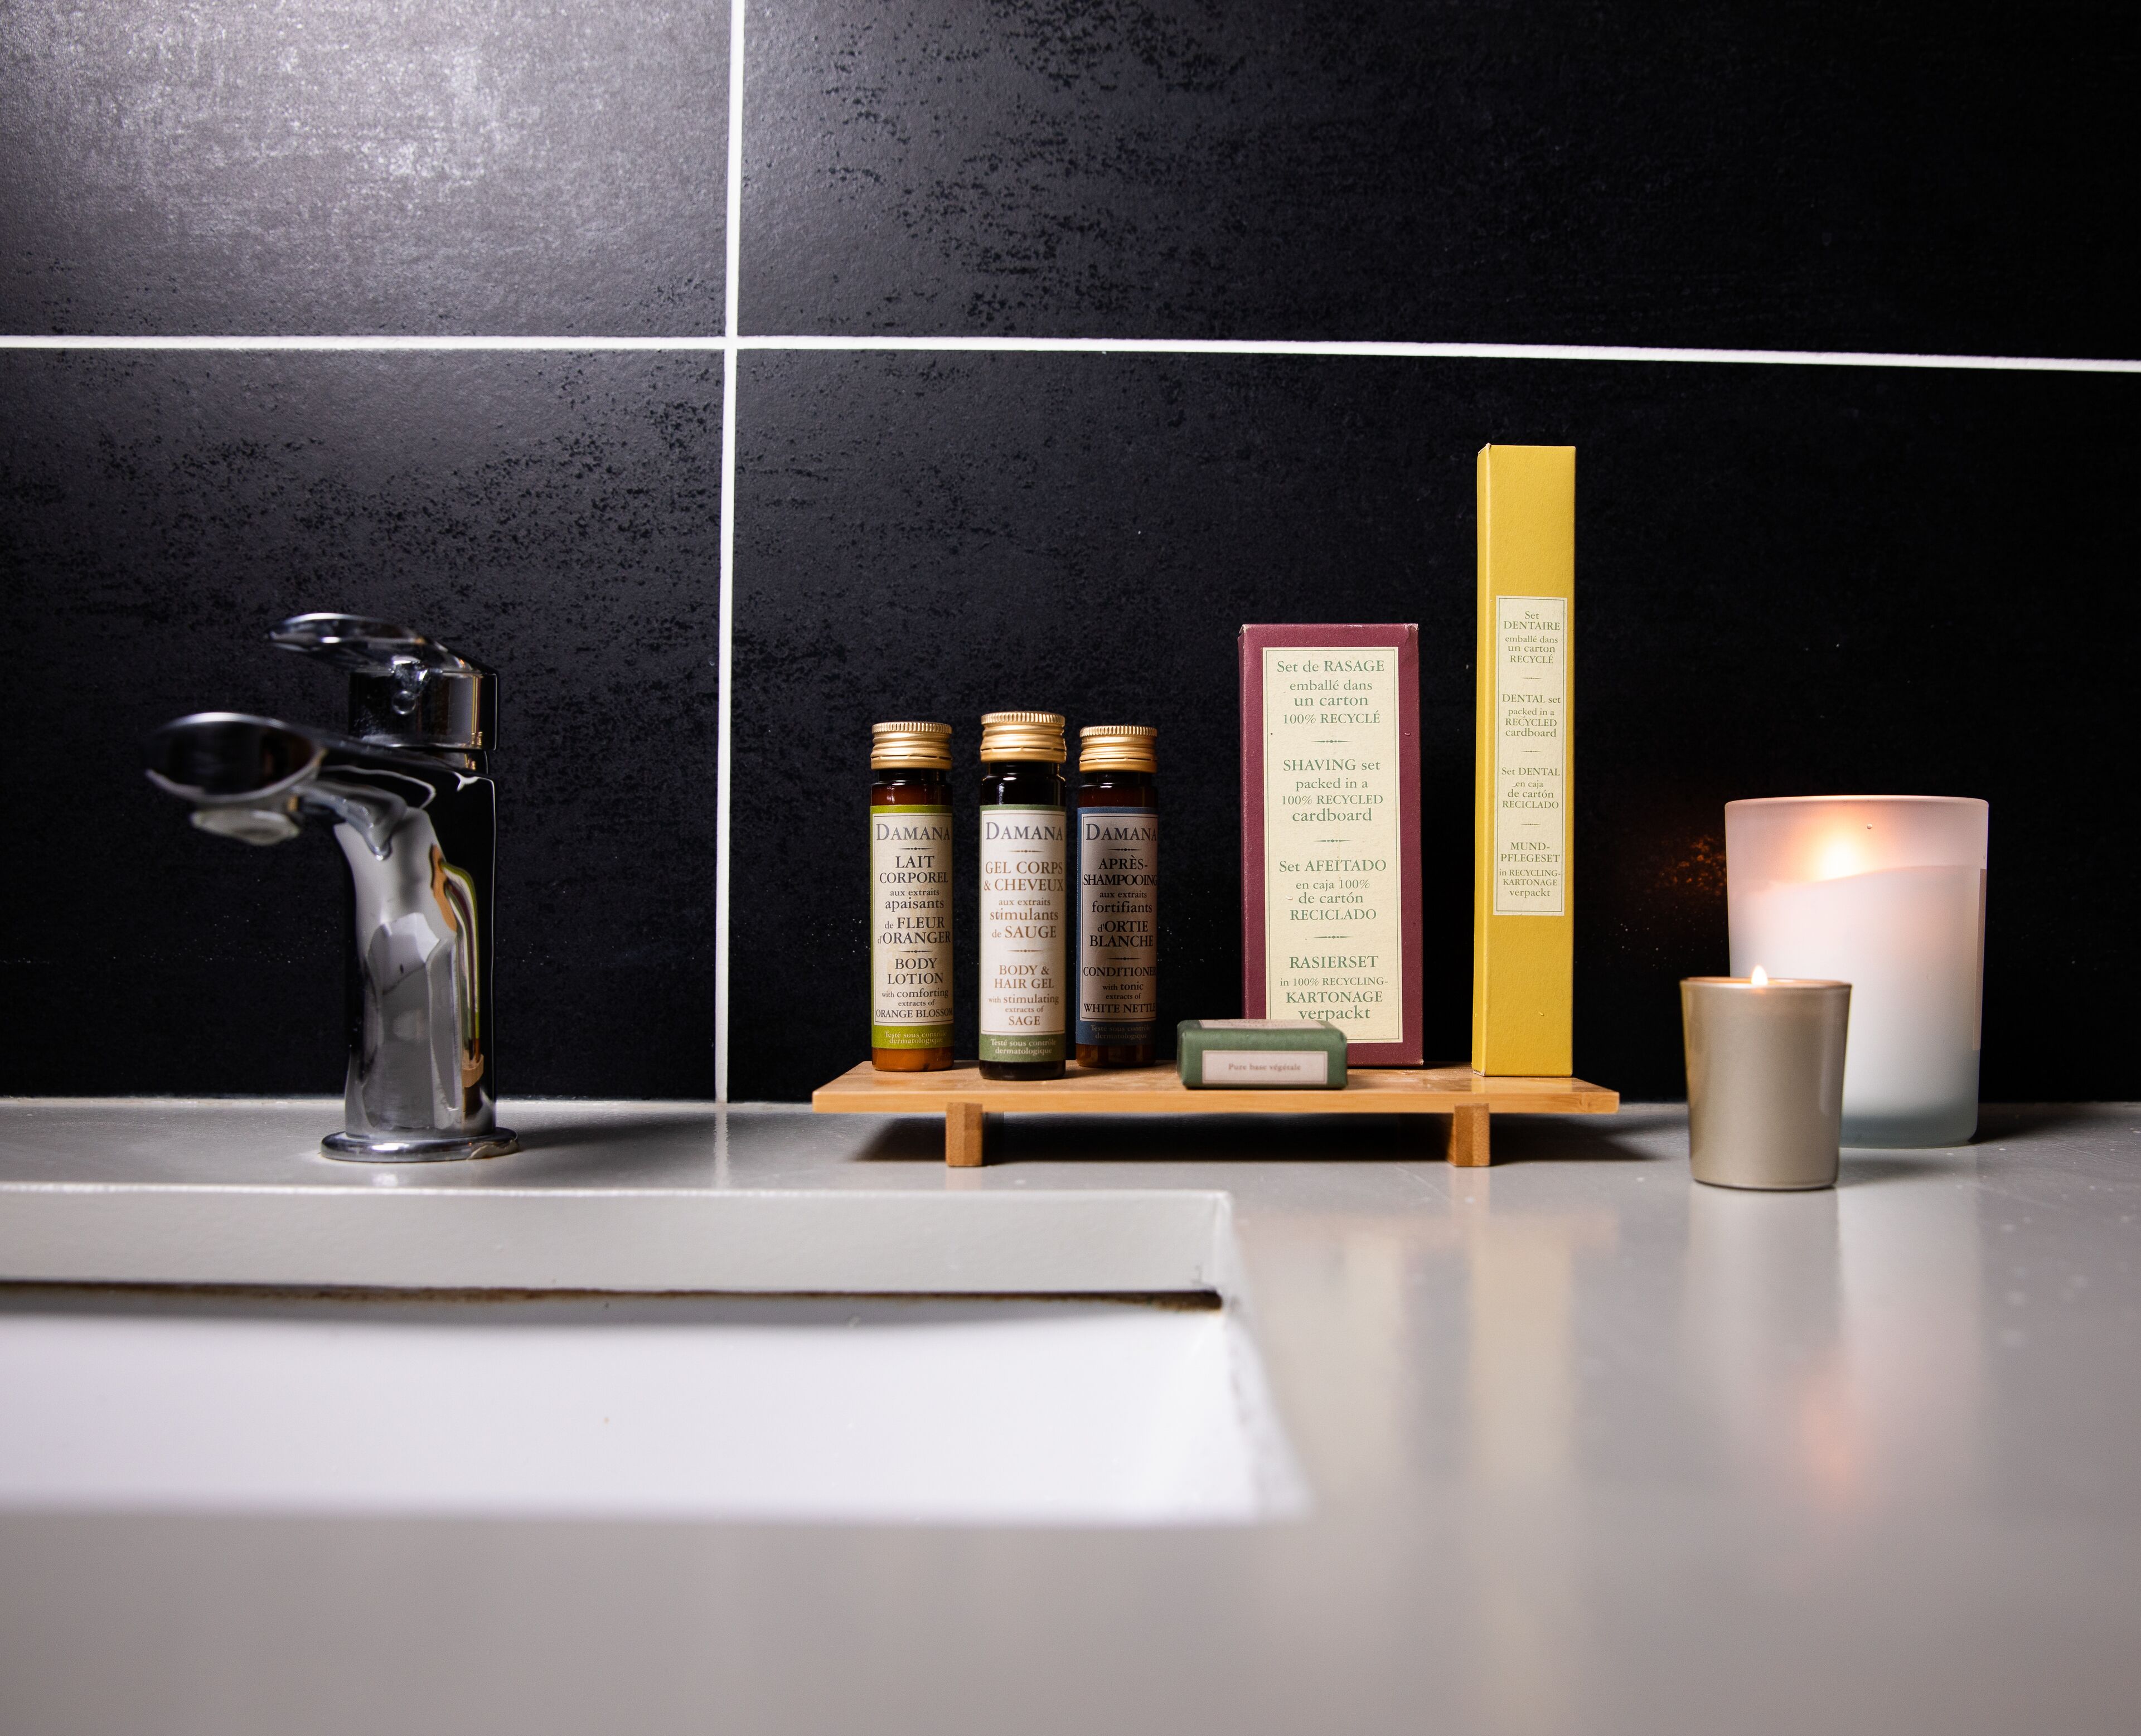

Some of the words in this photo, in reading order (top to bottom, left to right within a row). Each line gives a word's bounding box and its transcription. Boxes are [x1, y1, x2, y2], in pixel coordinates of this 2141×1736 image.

[1524, 611, 1539, 619] Set
[1503, 620, 1561, 631] DENTAIRE
[1510, 654, 1553, 664] RECYCLÉ
[1277, 661, 1298, 672] Set
[1302, 660, 1319, 672] de
[1324, 660, 1384, 672] RASAGE
[1290, 680, 1339, 691] emballé
[1343, 680, 1372, 690] dans
[1294, 697, 1314, 706] un
[1319, 696, 1369, 706] carton
[1502, 694, 1546, 704] DENTAL
[1283, 714, 1316, 724] 100%
[1320, 710, 1380, 724] RECYCLÉ
[1508, 708, 1537, 716] packed
[1505, 717, 1557, 727] RECYCLED
[1505, 728, 1557, 737] cardboard
[1283, 759, 1357, 771] SHAVING
[1361, 760, 1380, 770] set
[1501, 767, 1515, 775] Set
[1518, 767, 1561, 776] DENTAL
[1295, 778, 1340, 792] packed
[1345, 778, 1357, 788] in
[1361, 780, 1368, 788] a
[1528, 780, 1544, 789] caja
[1507, 789, 1519, 798] de
[1522, 789, 1554, 798] cartón
[1282, 796, 1312, 805] 100%
[1316, 794, 1383, 804] RECYCLED
[1502, 800, 1559, 809] RECICLADO
[1292, 807, 1372, 822] cardboard
[1510, 842, 1551, 851] MUND-
[896, 856, 934, 868] LAIT
[1098, 855, 1147, 870] APRÈS-
[1500, 854, 1561, 862] PFLEGESET
[986, 861, 1011, 874] GEL
[1016, 861, 1063, 874] CORPS
[1279, 860, 1300, 872] Set
[1304, 859, 1387, 872] AFEITADO
[880, 872, 948, 883] CORPOREL
[984, 880, 990, 890] &
[995, 879, 1063, 891] CHEVEUX
[1312, 880, 1335, 892] caja
[1339, 879, 1370, 889] 100%
[1298, 892, 1315, 904] de
[1319, 891, 1364, 904] cartón
[1509, 888, 1551, 899] verpackt
[885, 897, 944, 912] apaisants
[1092, 901, 1152, 913] fortifiants
[990, 908, 1058, 920] stimulants
[1290, 909, 1377, 920] RECICLADO
[897, 917, 945, 928] FLEUR
[1098, 920, 1148, 932] d'ORTIE
[992, 929, 1001, 938] de
[1005, 926, 1056, 938] SAUGE
[878, 932, 951, 944] d'ORANGER
[1090, 935, 1153, 947] BLANCHE
[895, 958, 937, 969] BODY
[1289, 955, 1379, 969] RASIERSET
[1000, 965, 1038, 975] BODY
[888, 973, 943, 985] LOTION
[995, 978, 1026, 988] HAIR
[1031, 978, 1054, 988] GEL
[1280, 978, 1290, 986] in
[1293, 977, 1319, 986] 100%
[1322, 977, 1388, 986] RECYCLING-
[1121, 982, 1144, 990] tonic
[897, 988, 948, 998] comforting
[1286, 991, 1383, 1003] KARTONAGE
[1004, 994, 1059, 1005] stimulating
[876, 1009, 913, 1018] ORANGE
[916, 1008, 953, 1017] BLOSSOM
[1084, 1003, 1120, 1013] WHITE
[1123, 1003, 1156, 1012] NETTLE
[1298, 1005, 1370, 1021] verpackt
[1009, 1016, 1040, 1025] SAGE
[995, 1048, 1052, 1056] dermatologique
[1269, 1063, 1301, 1072] végétale
